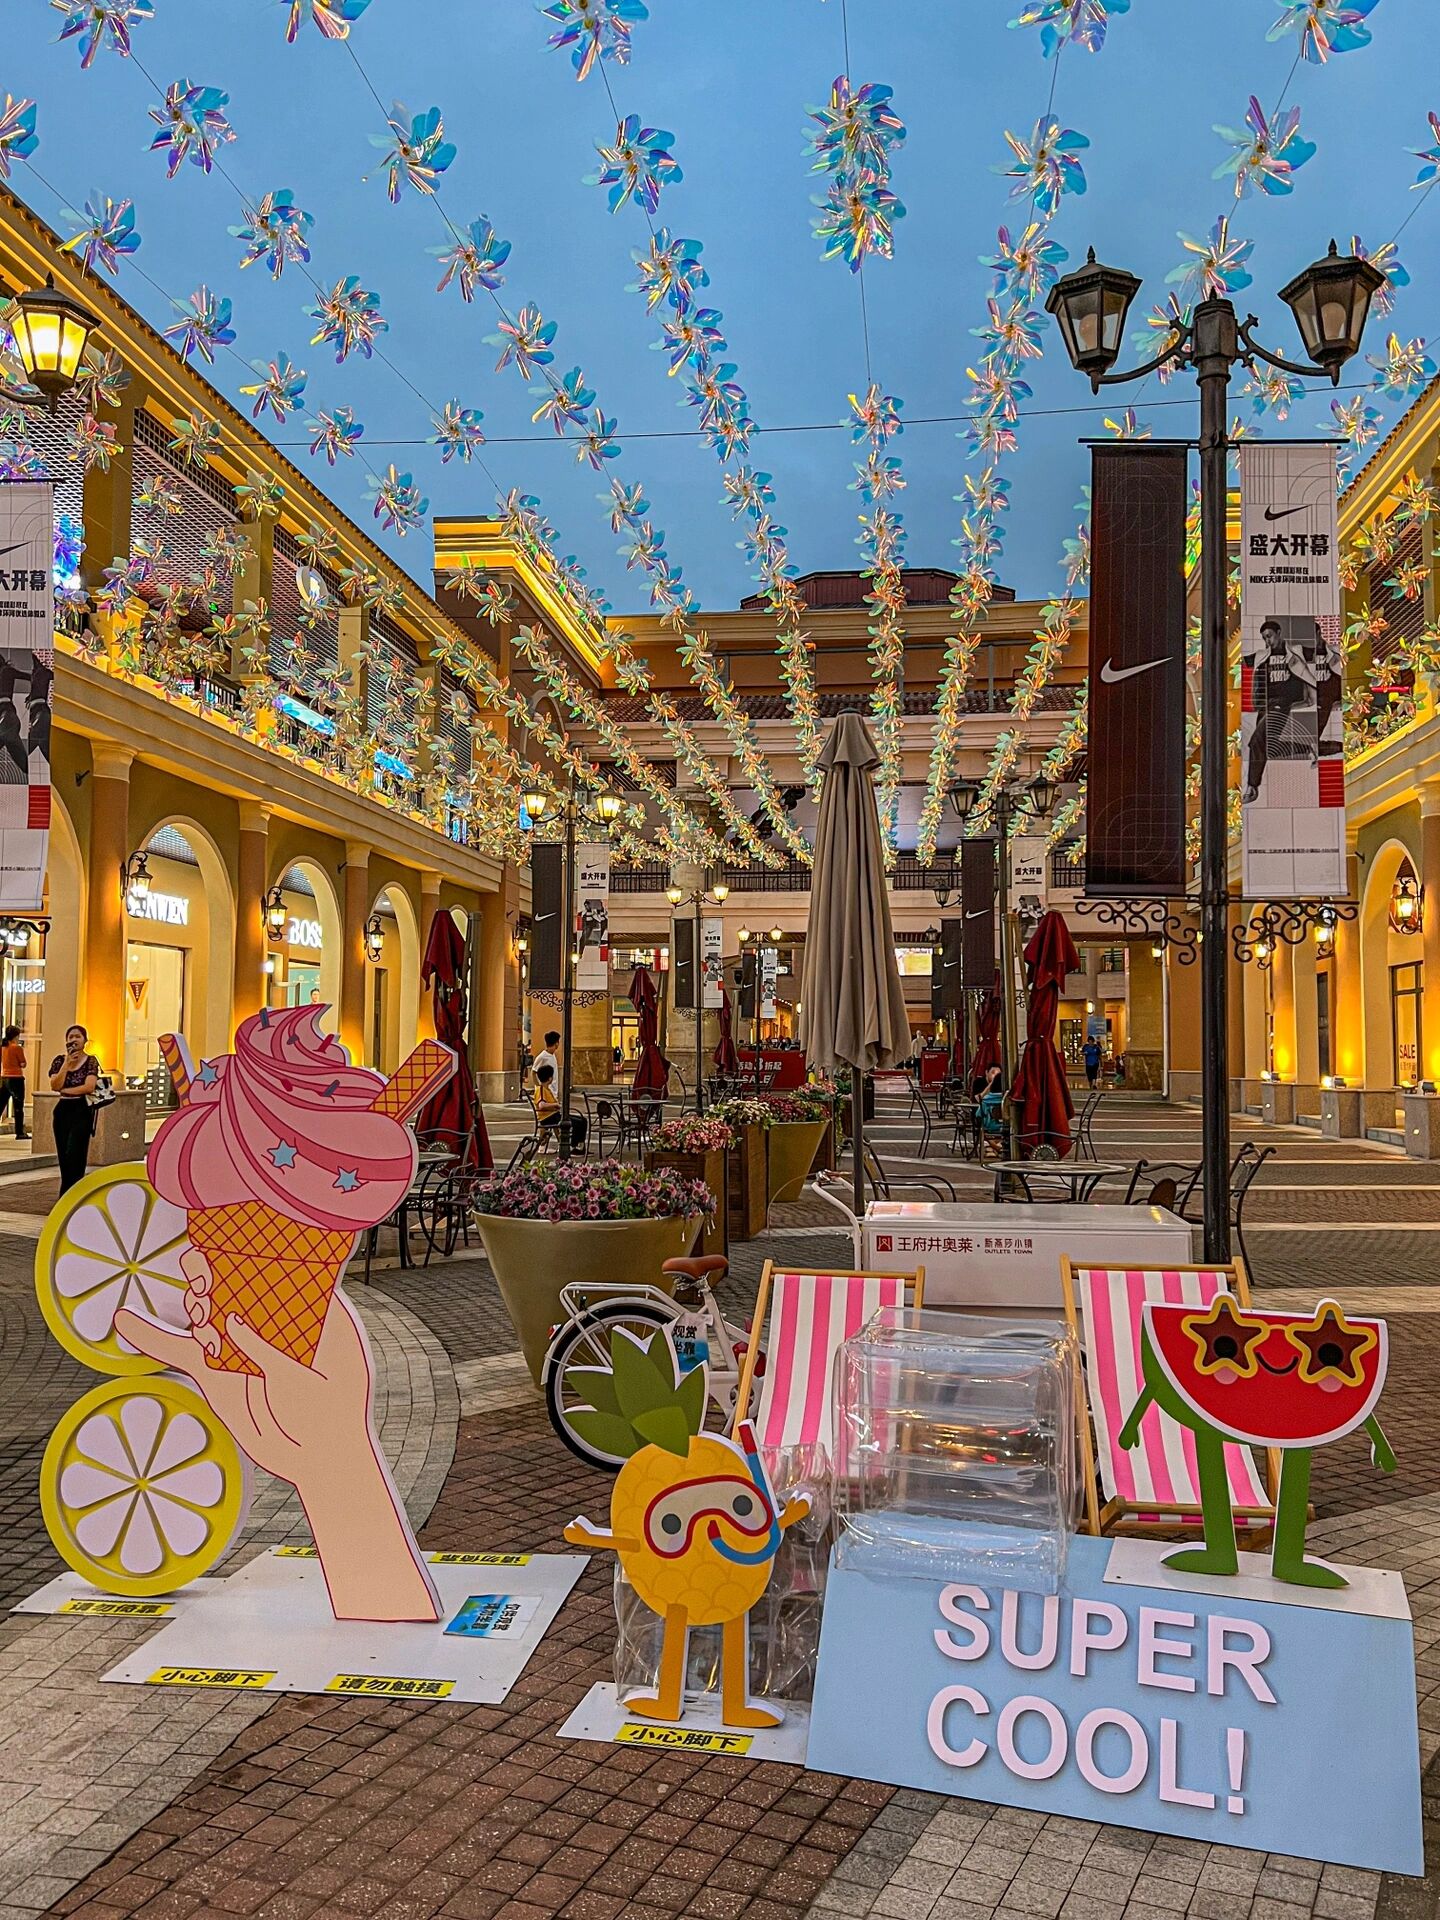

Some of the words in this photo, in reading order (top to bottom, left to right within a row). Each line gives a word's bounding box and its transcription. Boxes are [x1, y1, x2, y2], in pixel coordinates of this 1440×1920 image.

[1249, 533, 1330, 556] 盛大开幕
[1399, 1044, 1416, 1059] SALE
[897, 1236, 974, 1253] 王府井奥莱
[984, 1237, 1033, 1249] 新燕莎小镇
[932, 1582, 1278, 1706] SUPER
[160, 1670, 265, 1685] 小心脚下
[338, 1677, 444, 1694] 请勿触摸
[628, 1727, 741, 1749] 小心脚下
[925, 1683, 1247, 1815] COOL!
